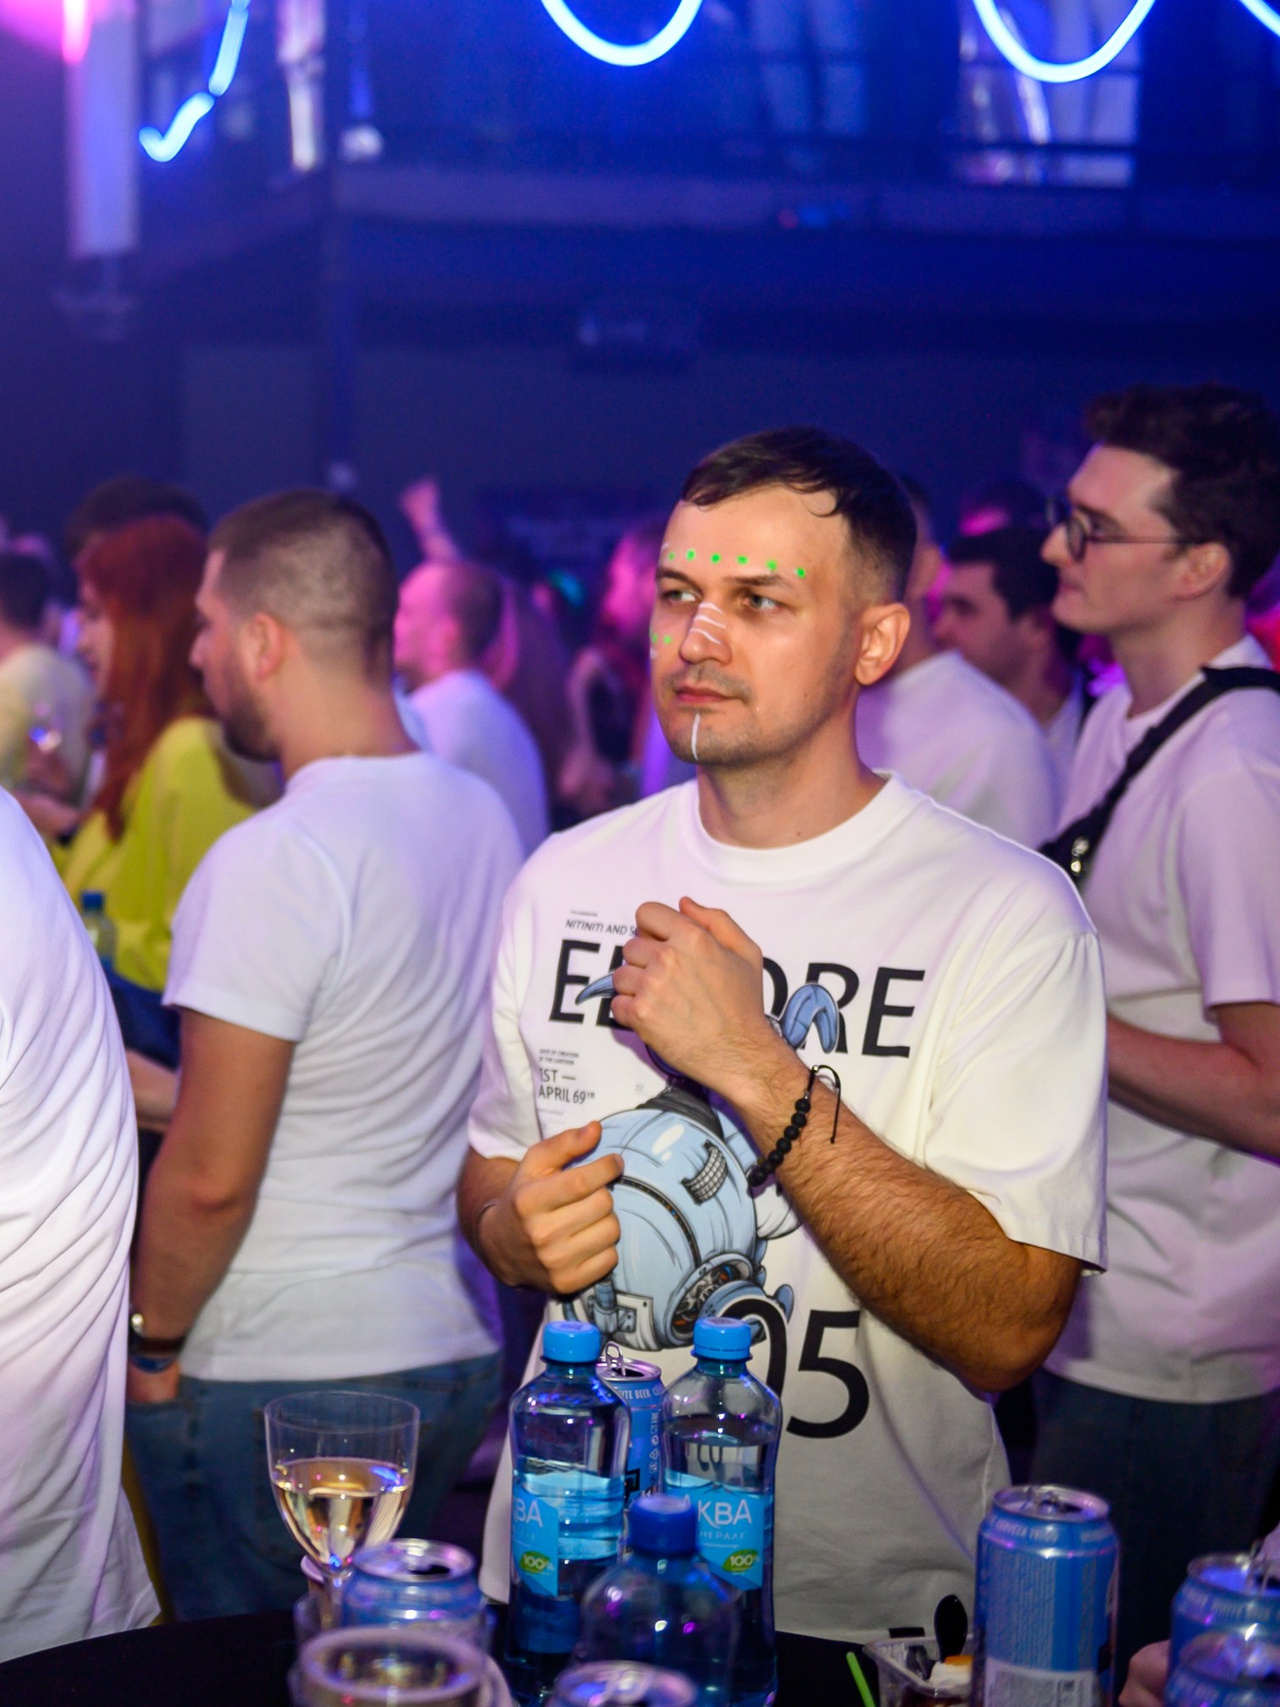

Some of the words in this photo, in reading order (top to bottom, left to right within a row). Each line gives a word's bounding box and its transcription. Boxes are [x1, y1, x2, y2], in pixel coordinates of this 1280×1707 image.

[605, 924, 628, 936] AND
[538, 1085, 571, 1103] APRIL
[634, 1389, 651, 1399] BEER
